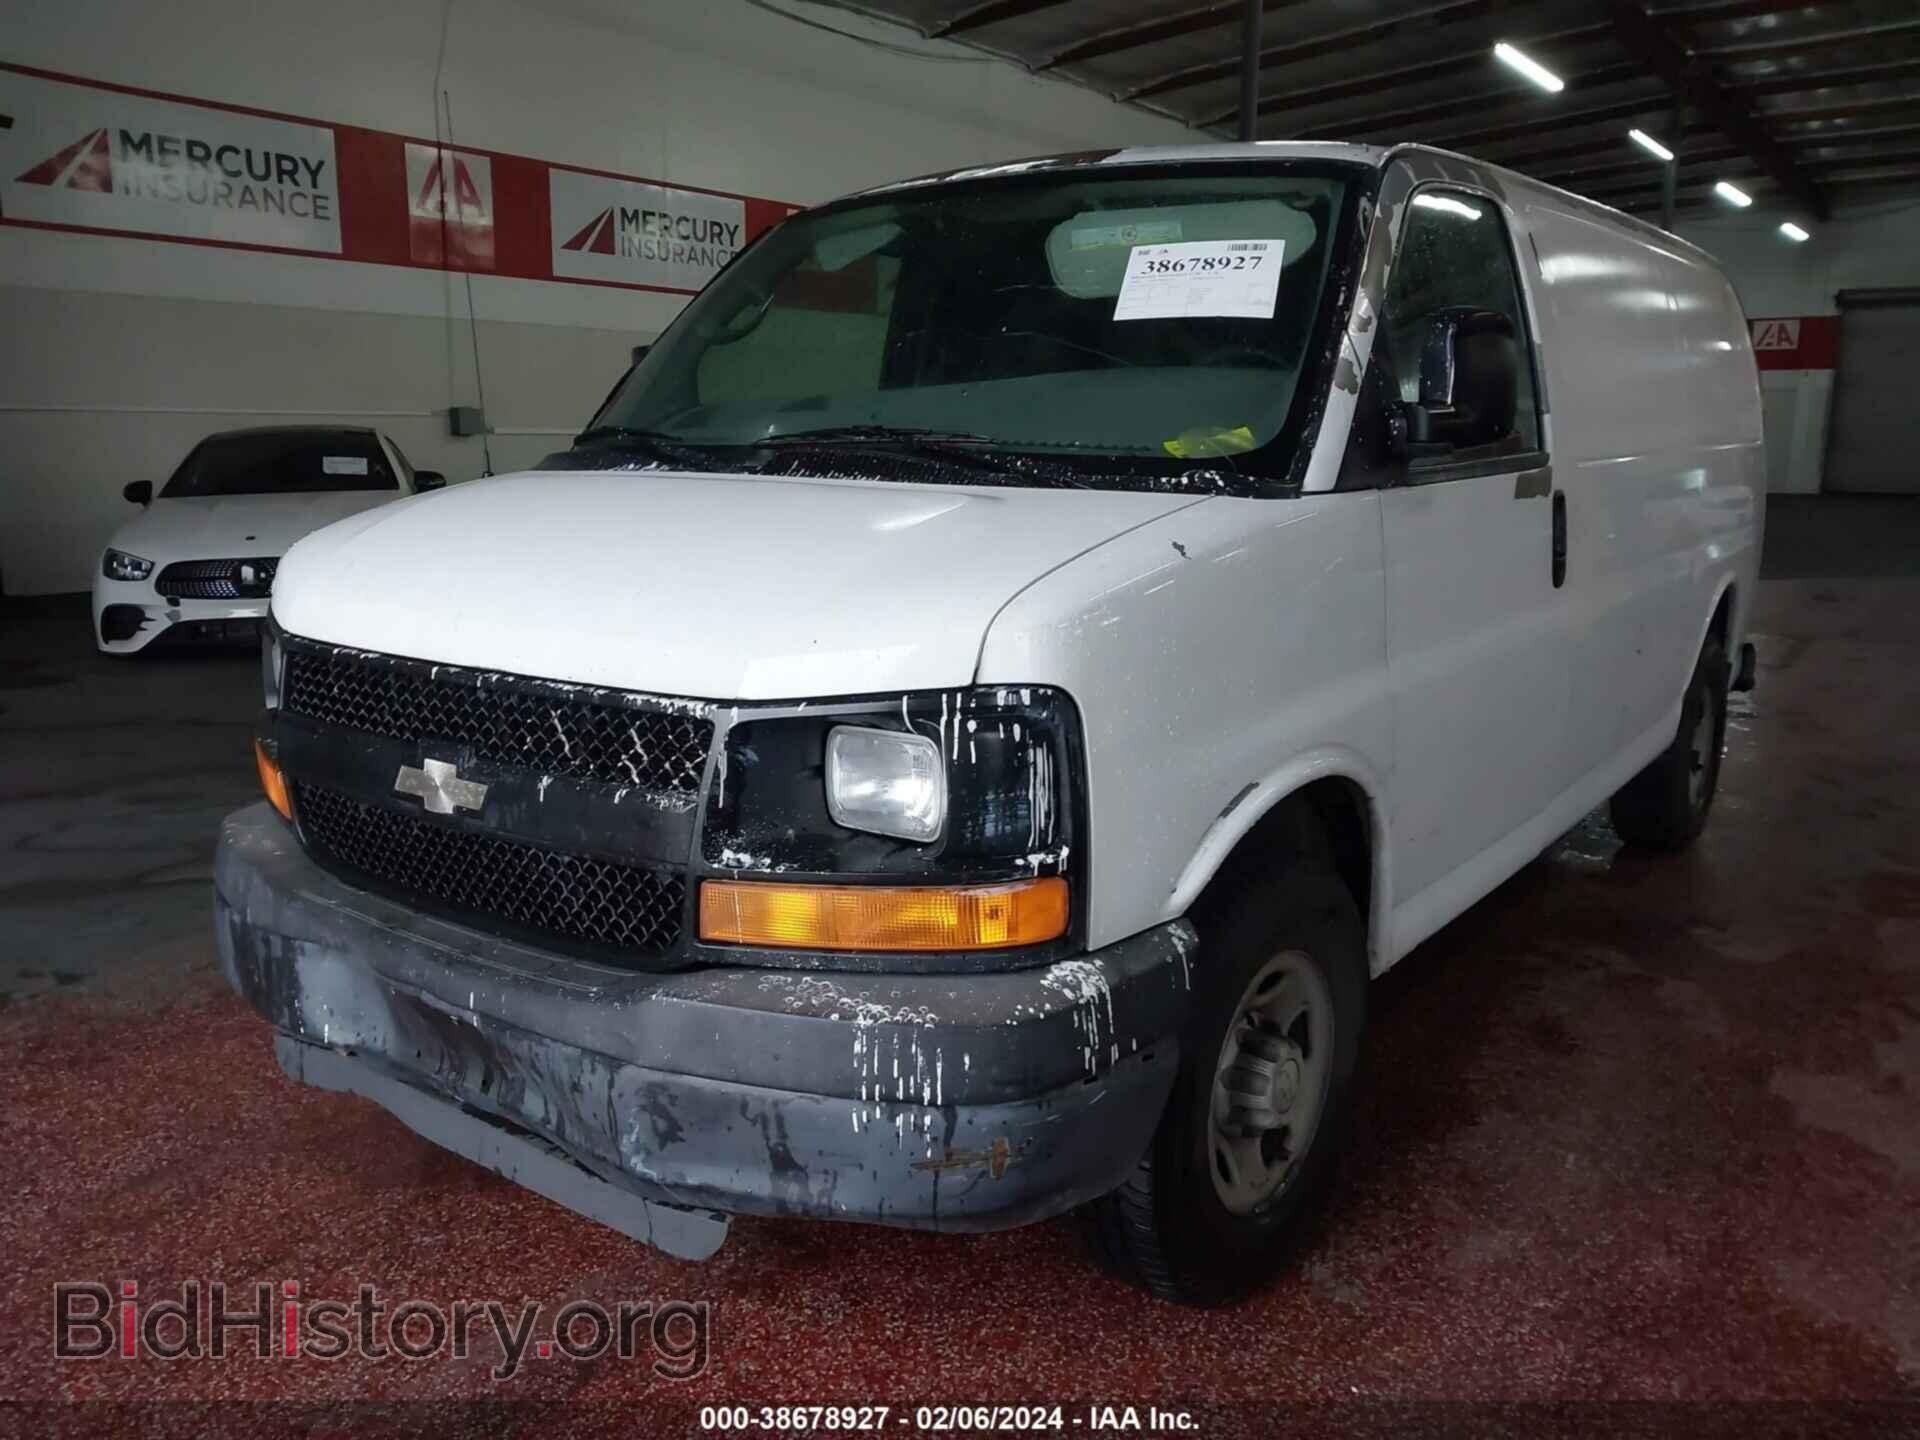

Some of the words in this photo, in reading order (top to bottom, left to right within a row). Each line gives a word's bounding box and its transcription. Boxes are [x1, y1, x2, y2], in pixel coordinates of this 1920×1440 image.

[119, 129, 325, 189] MERCURY
[620, 206, 739, 248] MERCURY
[1140, 255, 1263, 275] 38678927
